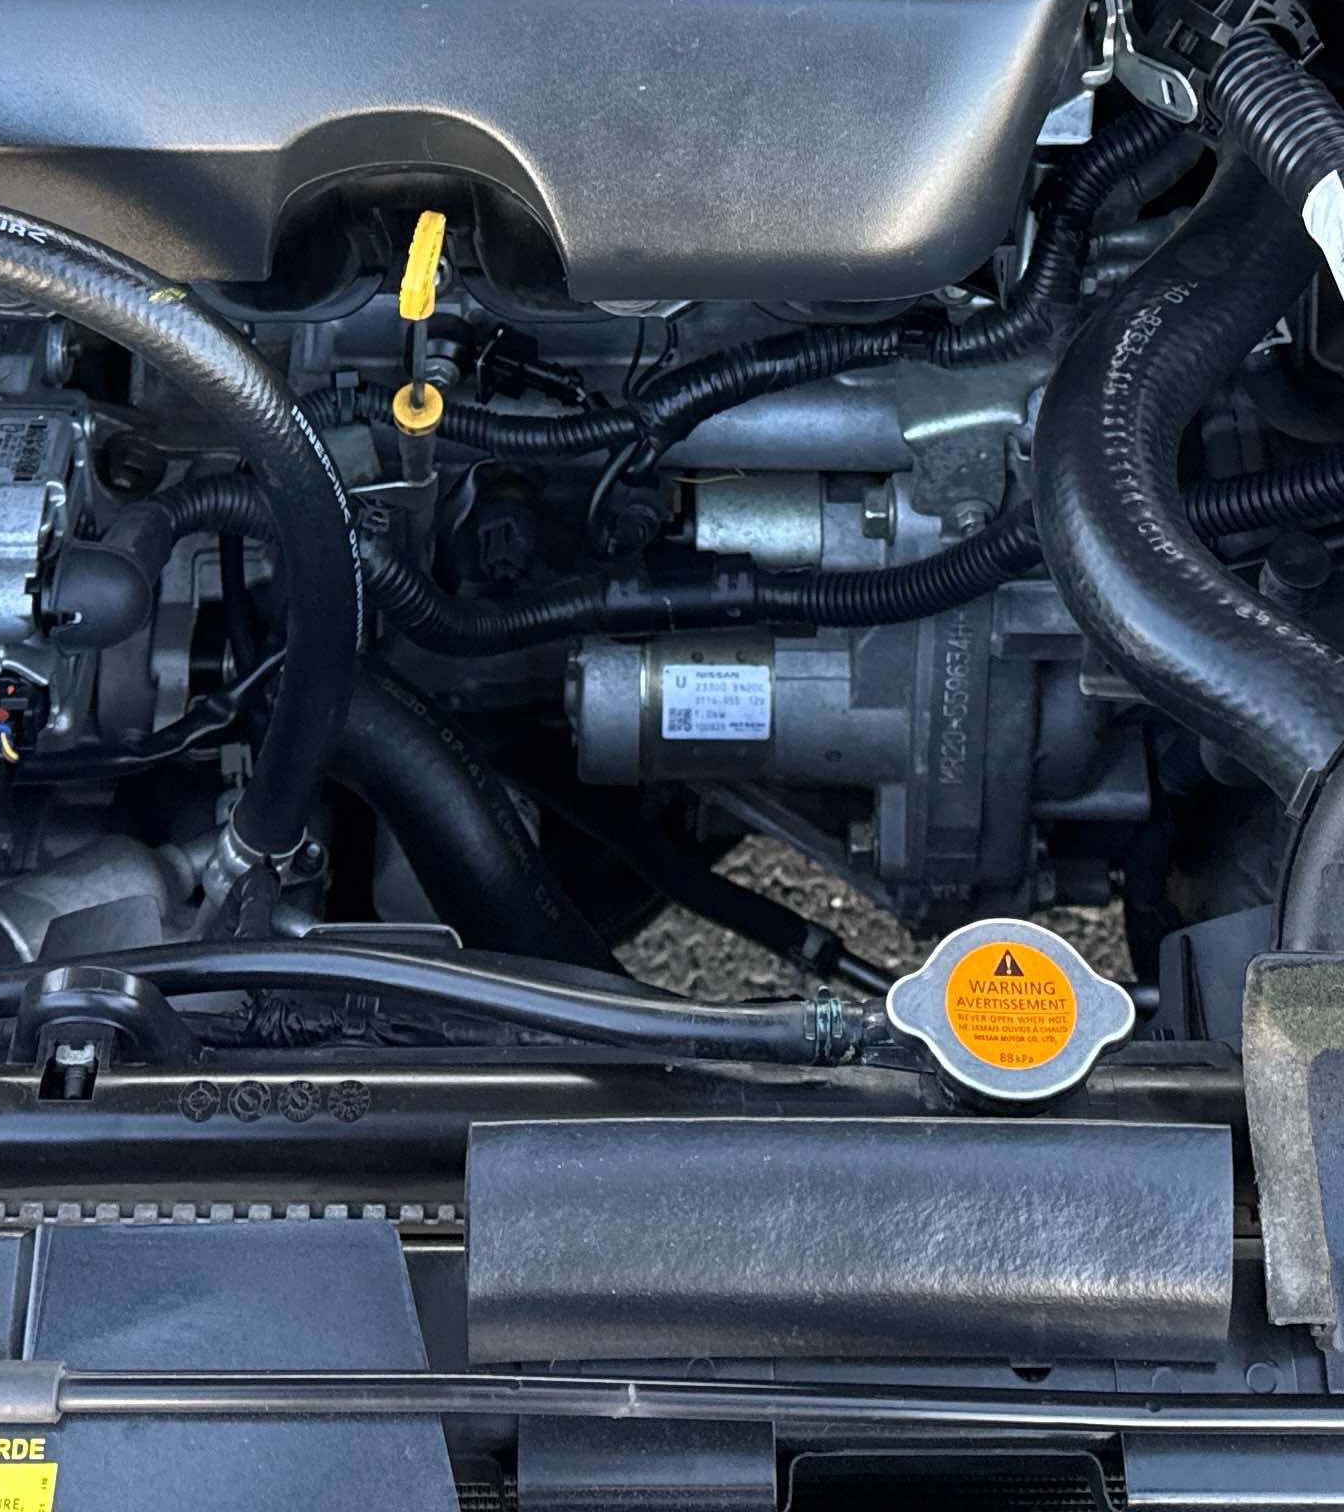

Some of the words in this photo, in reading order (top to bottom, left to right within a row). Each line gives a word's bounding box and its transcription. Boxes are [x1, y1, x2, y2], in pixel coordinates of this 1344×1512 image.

[675, 676, 687, 689] U
[969, 980, 1056, 995] WARNING
[957, 996, 1067, 1010] AVERTISSEMENT
[958, 1013, 986, 1022] NEVER
[991, 1015, 1013, 1023] OPEN
[1017, 1016, 1044, 1024] WHEN
